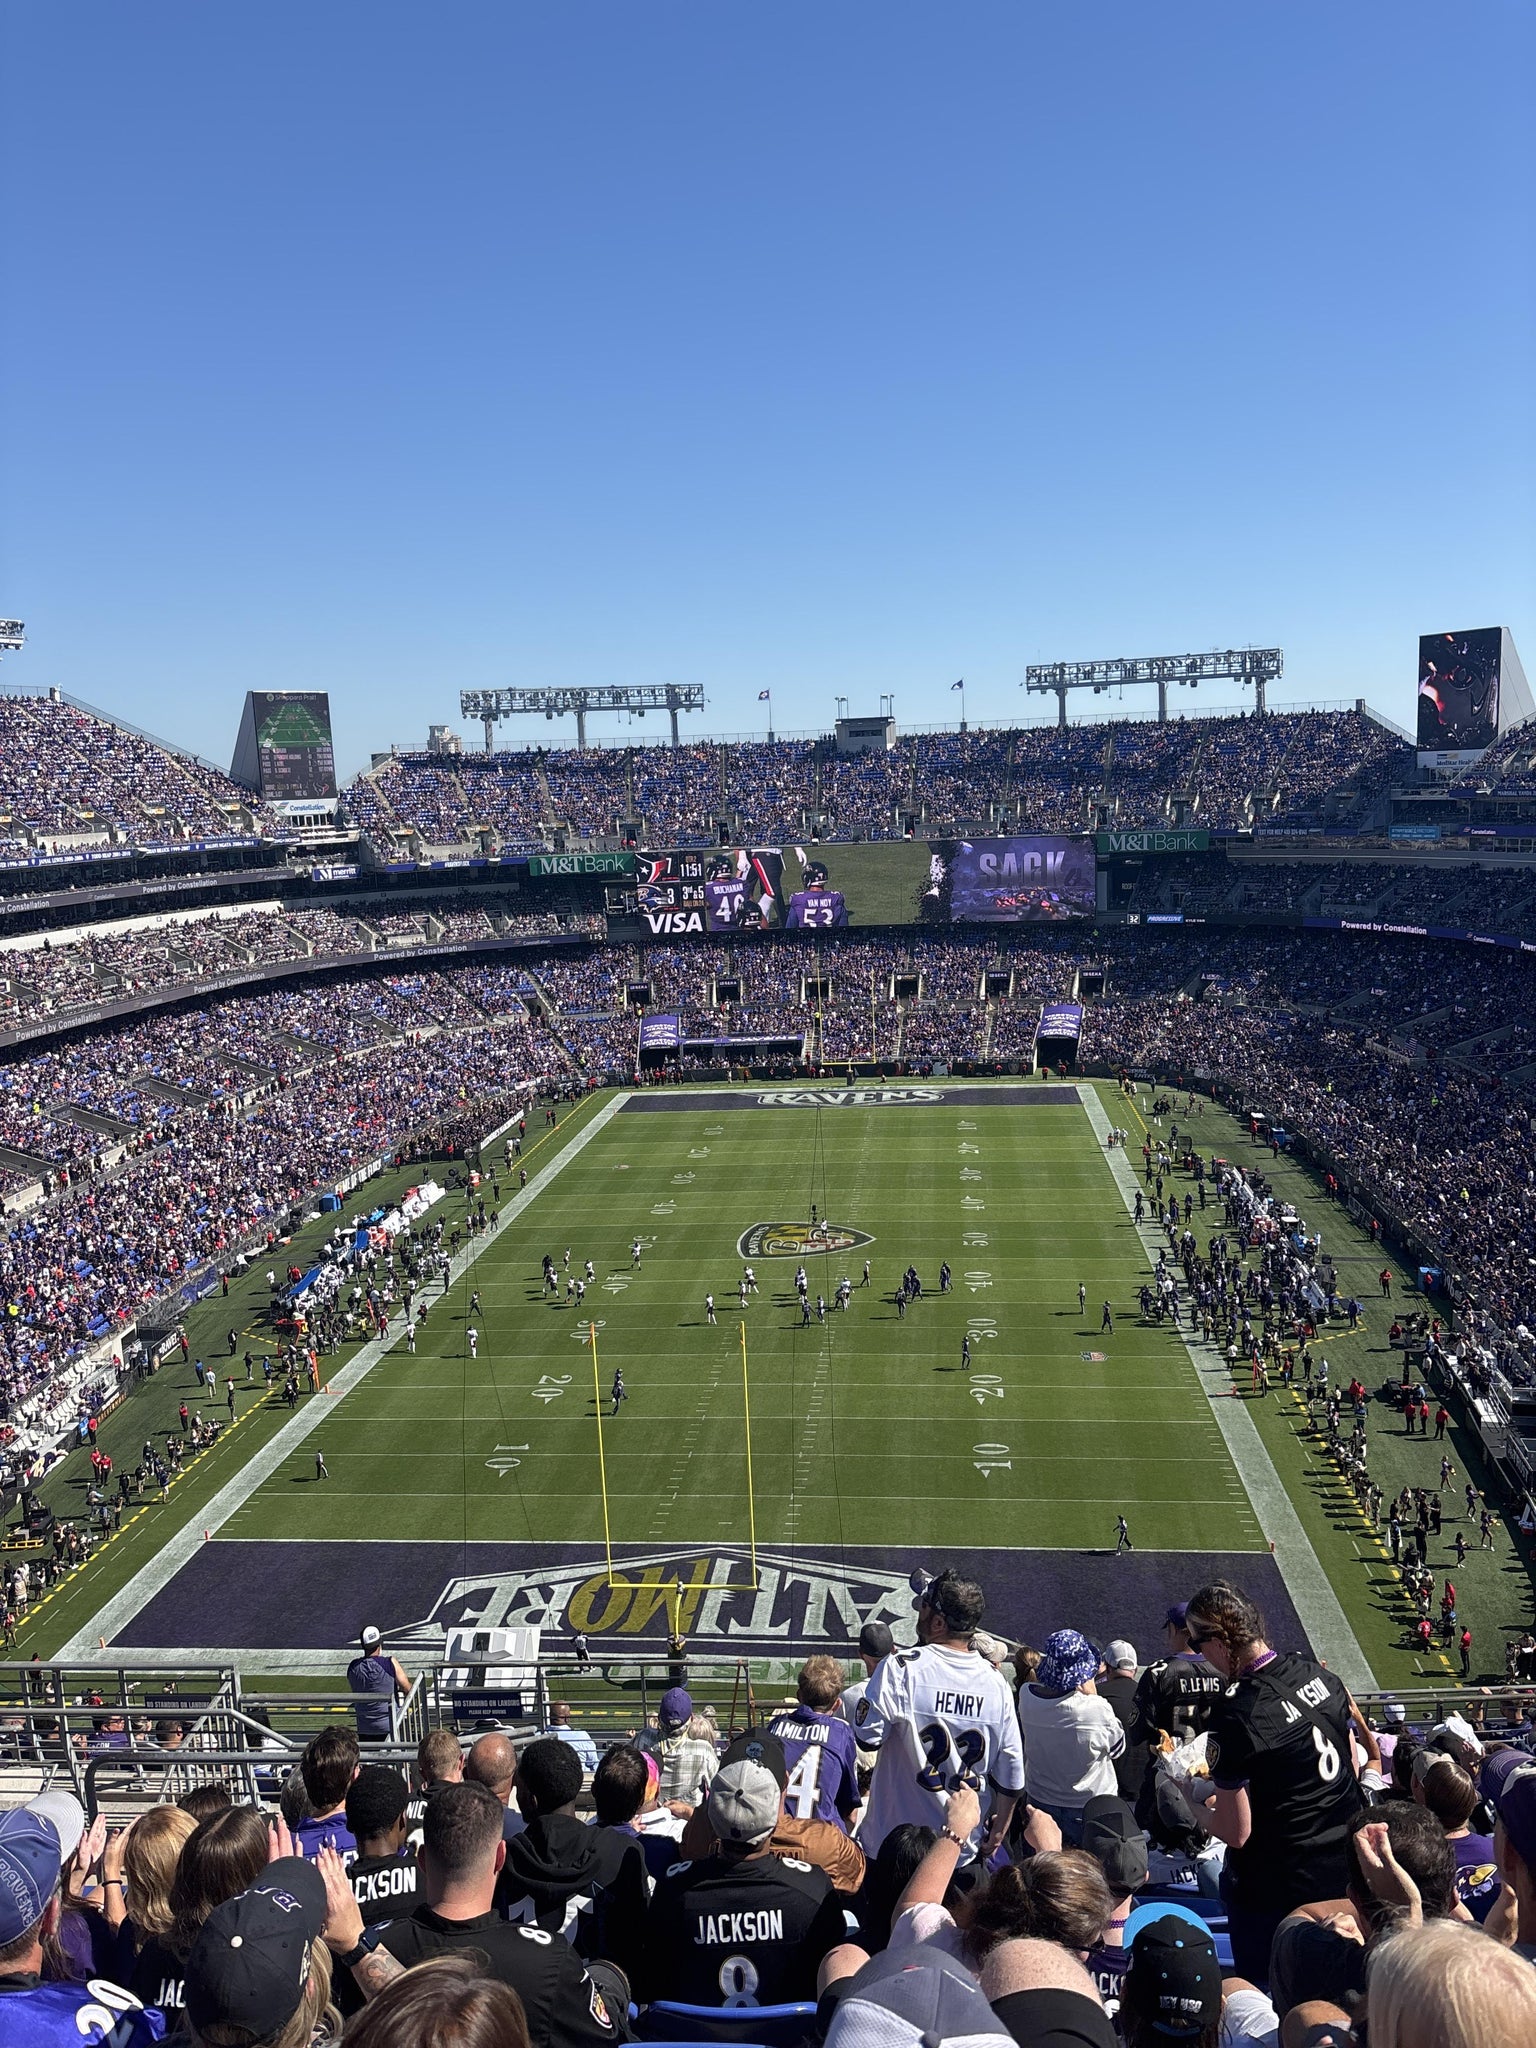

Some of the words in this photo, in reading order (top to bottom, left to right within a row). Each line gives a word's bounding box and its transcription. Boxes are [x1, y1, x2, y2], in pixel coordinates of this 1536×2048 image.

[290, 801, 326, 812] Constellation
[1108, 834, 1153, 852] M&T
[1154, 832, 1198, 850] Bank
[333, 867, 356, 876] merritt
[540, 857, 582, 874] M&T
[584, 856, 624, 872] Bank
[666, 858, 672, 874] 7
[680, 864, 702, 877] 11:51
[980, 851, 1065, 886] SACK
[143, 884, 166, 893] Powered
[168, 883, 176, 891] by
[177, 879, 217, 890] Constellation
[682, 886, 692, 900] 3rd
[698, 886, 704, 899] 5
[712, 883, 744, 895] BUCHANAN
[667, 888, 674, 904] 3
[807, 899, 818, 907] VAN
[820, 899, 831, 907] NOY
[7, 901, 50, 912] Constellation
[643, 912, 703, 933] VISA
[804, 909, 833, 927] 53
[1342, 920, 1371, 930] Powered
[1372, 922, 1382, 931] by
[1383, 924, 1427, 935] Constellation
[374, 951, 405, 961] Powered
[407, 950, 415, 958] by
[418, 945, 467, 956] Constellation
[194, 982, 218, 994] Powered
[227, 972, 265, 986] Constellation
[16, 1026, 46, 1041] Powered
[48, 1024, 56, 1032] by
[58, 1012, 101, 1028] Constellation
[762, 1090, 940, 1105] RAVENS
[628, 1236, 658, 1248] 50
[748, 1226, 770, 1255] RAVENS
[962, 1232, 989, 1246] 50
[601, 1275, 633, 1290] 40
[964, 1271, 993, 1288] 40
[570, 1320, 606, 1339] 30
[967, 1318, 998, 1338] 30
[531, 1375, 572, 1397] 20
[969, 1374, 1004, 1398] 20
[485, 1444, 530, 1468] 10
[973, 1443, 1012, 1470] 10
[444, 1557, 921, 1647] BALTIMORE
[1180, 1677, 1219, 1693] R.LEWIS
[1225, 1682, 1240, 1696] 8
[935, 1691, 984, 1717] HENRY
[1281, 1677, 1331, 1724] JAKSON
[916, 1724, 985, 1792] 22
[1312, 1725, 1339, 1781] 8
[786, 1745, 821, 1819] 4
[666, 1860, 693, 1877] 8
[782, 1857, 812, 1872] 8
[0, 1858, 36, 1927] RAVENS
[694, 1909, 783, 1944] JACKSON
[519, 1927, 552, 1944] 8
